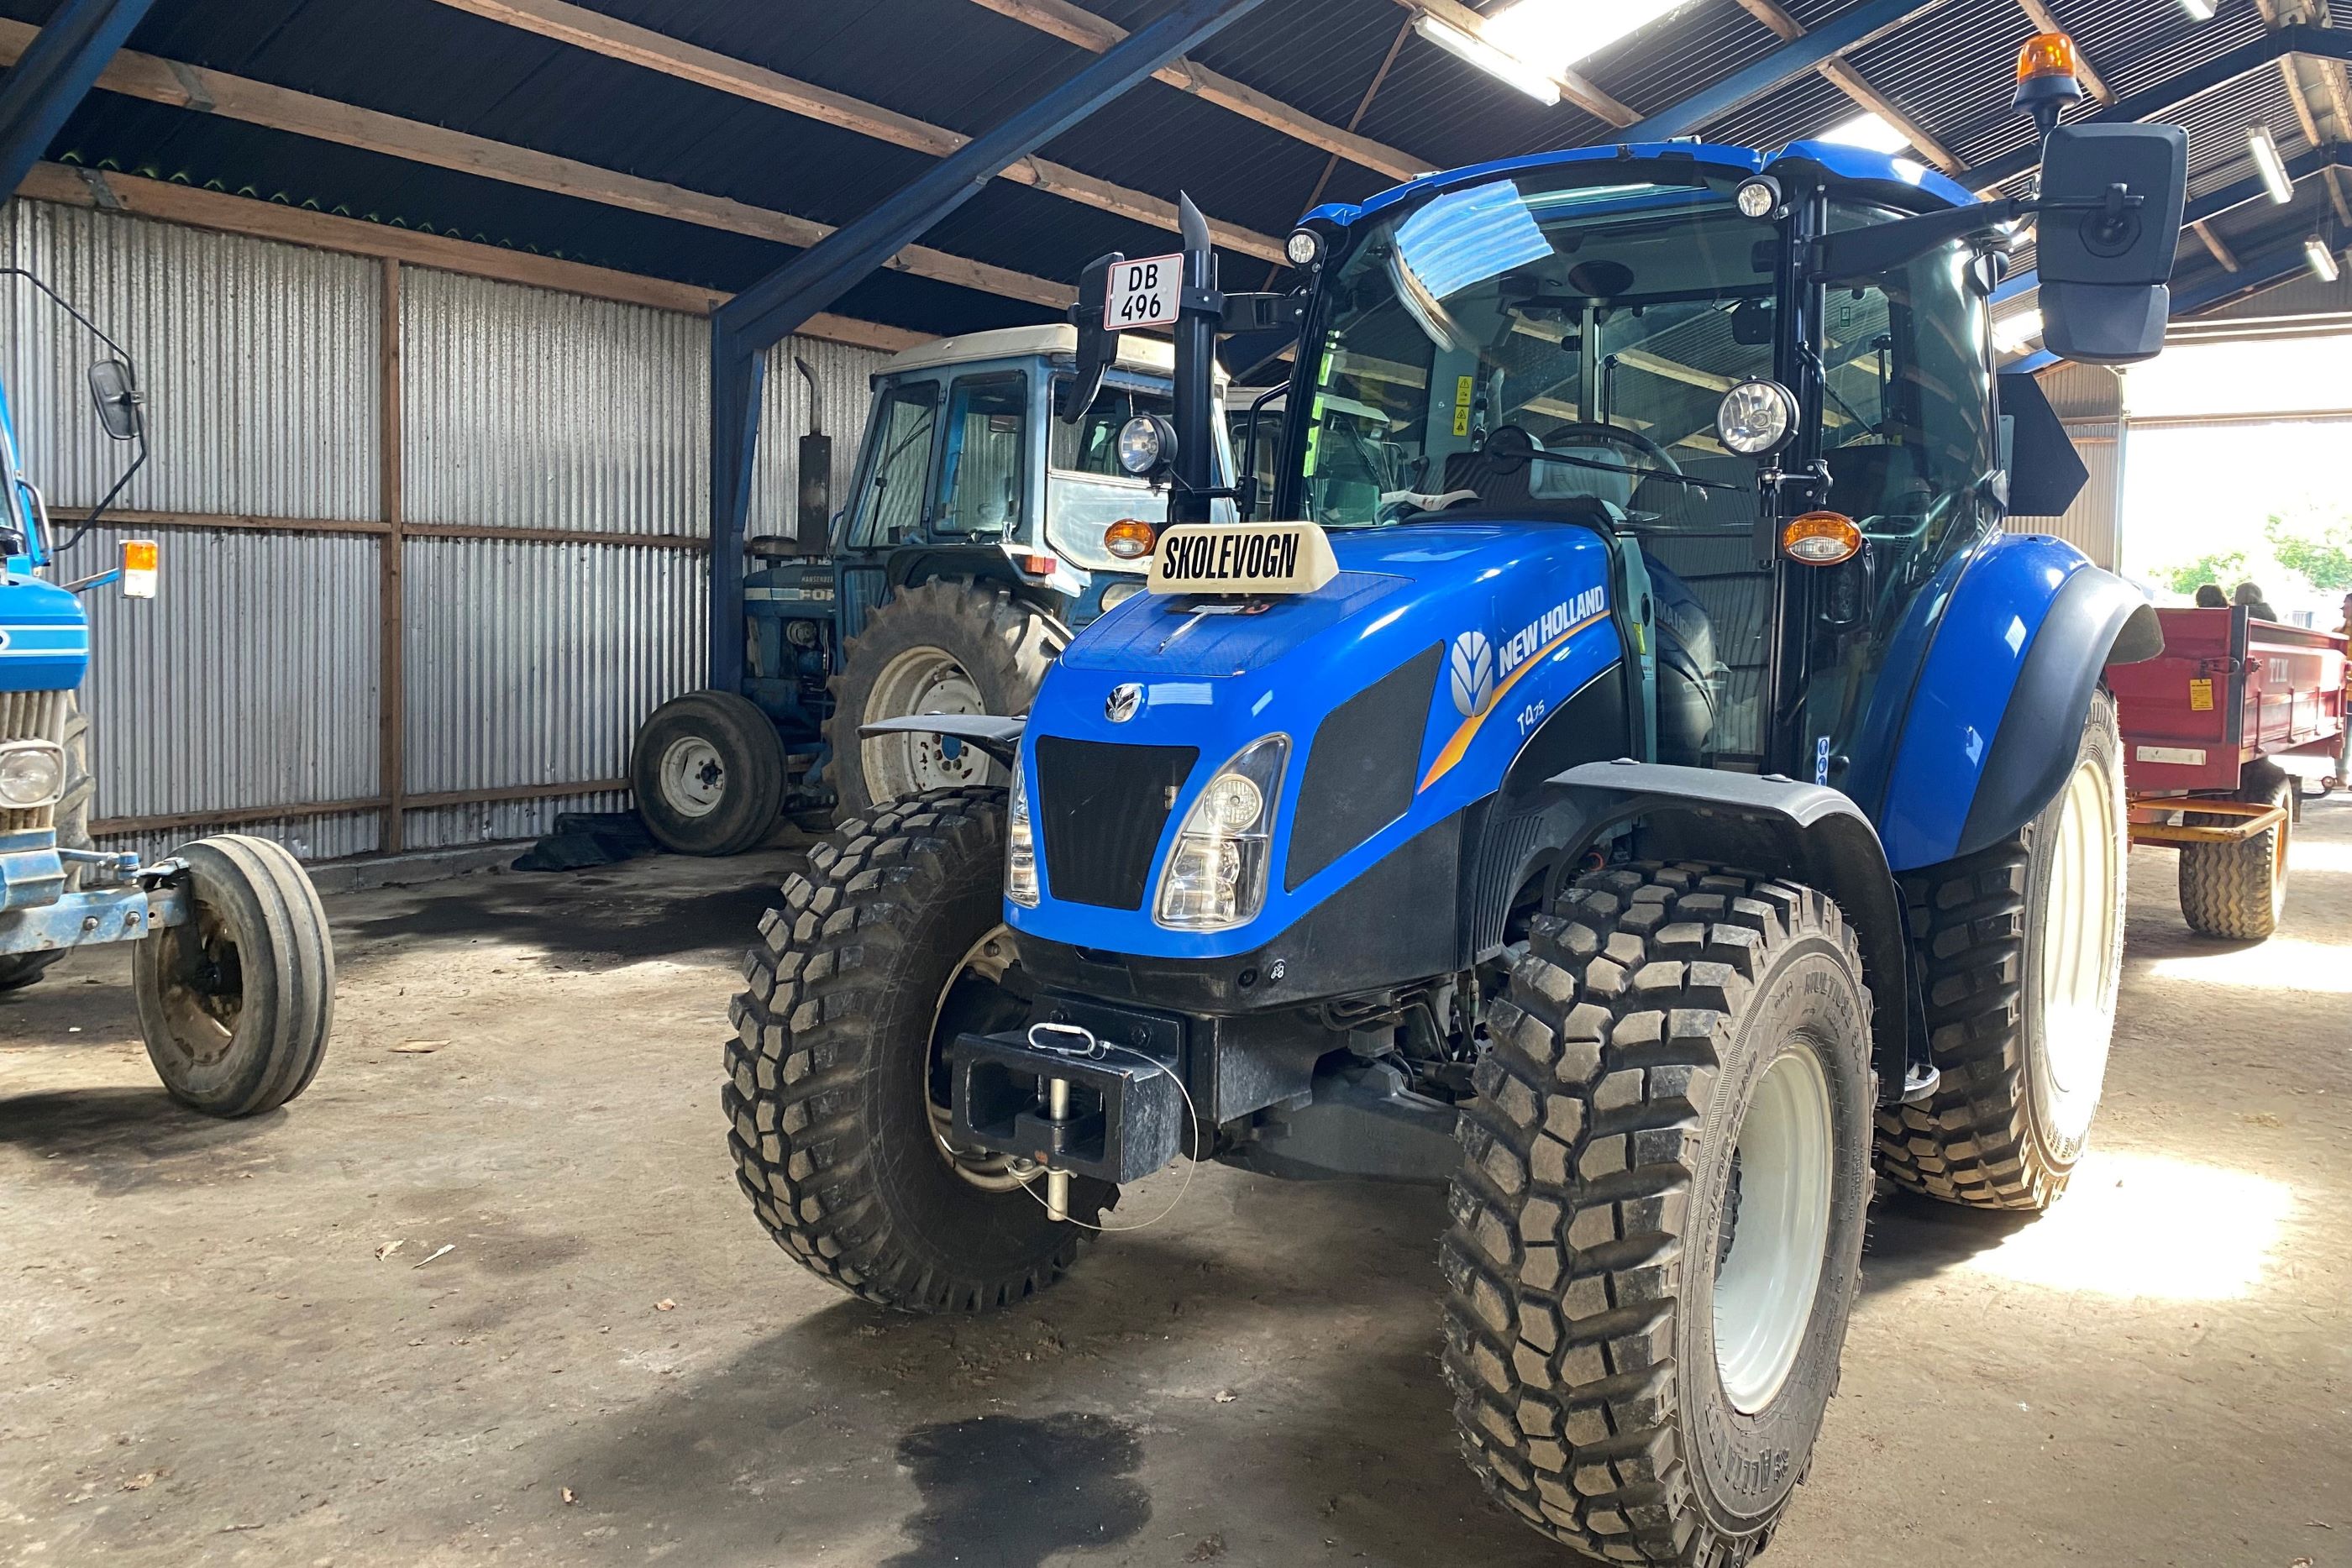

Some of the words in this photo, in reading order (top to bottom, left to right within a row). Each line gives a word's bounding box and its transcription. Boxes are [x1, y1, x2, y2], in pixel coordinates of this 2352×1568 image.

[1129, 264, 1158, 292] DB
[1121, 293, 1161, 321] 496
[1163, 533, 1299, 579] SKOLEVOGN
[800, 589, 835, 600] FOR
[1499, 620, 1539, 679] NEW
[1541, 585, 1605, 645] HOLLAND
[1804, 971, 1854, 1028] MULTIUSE
